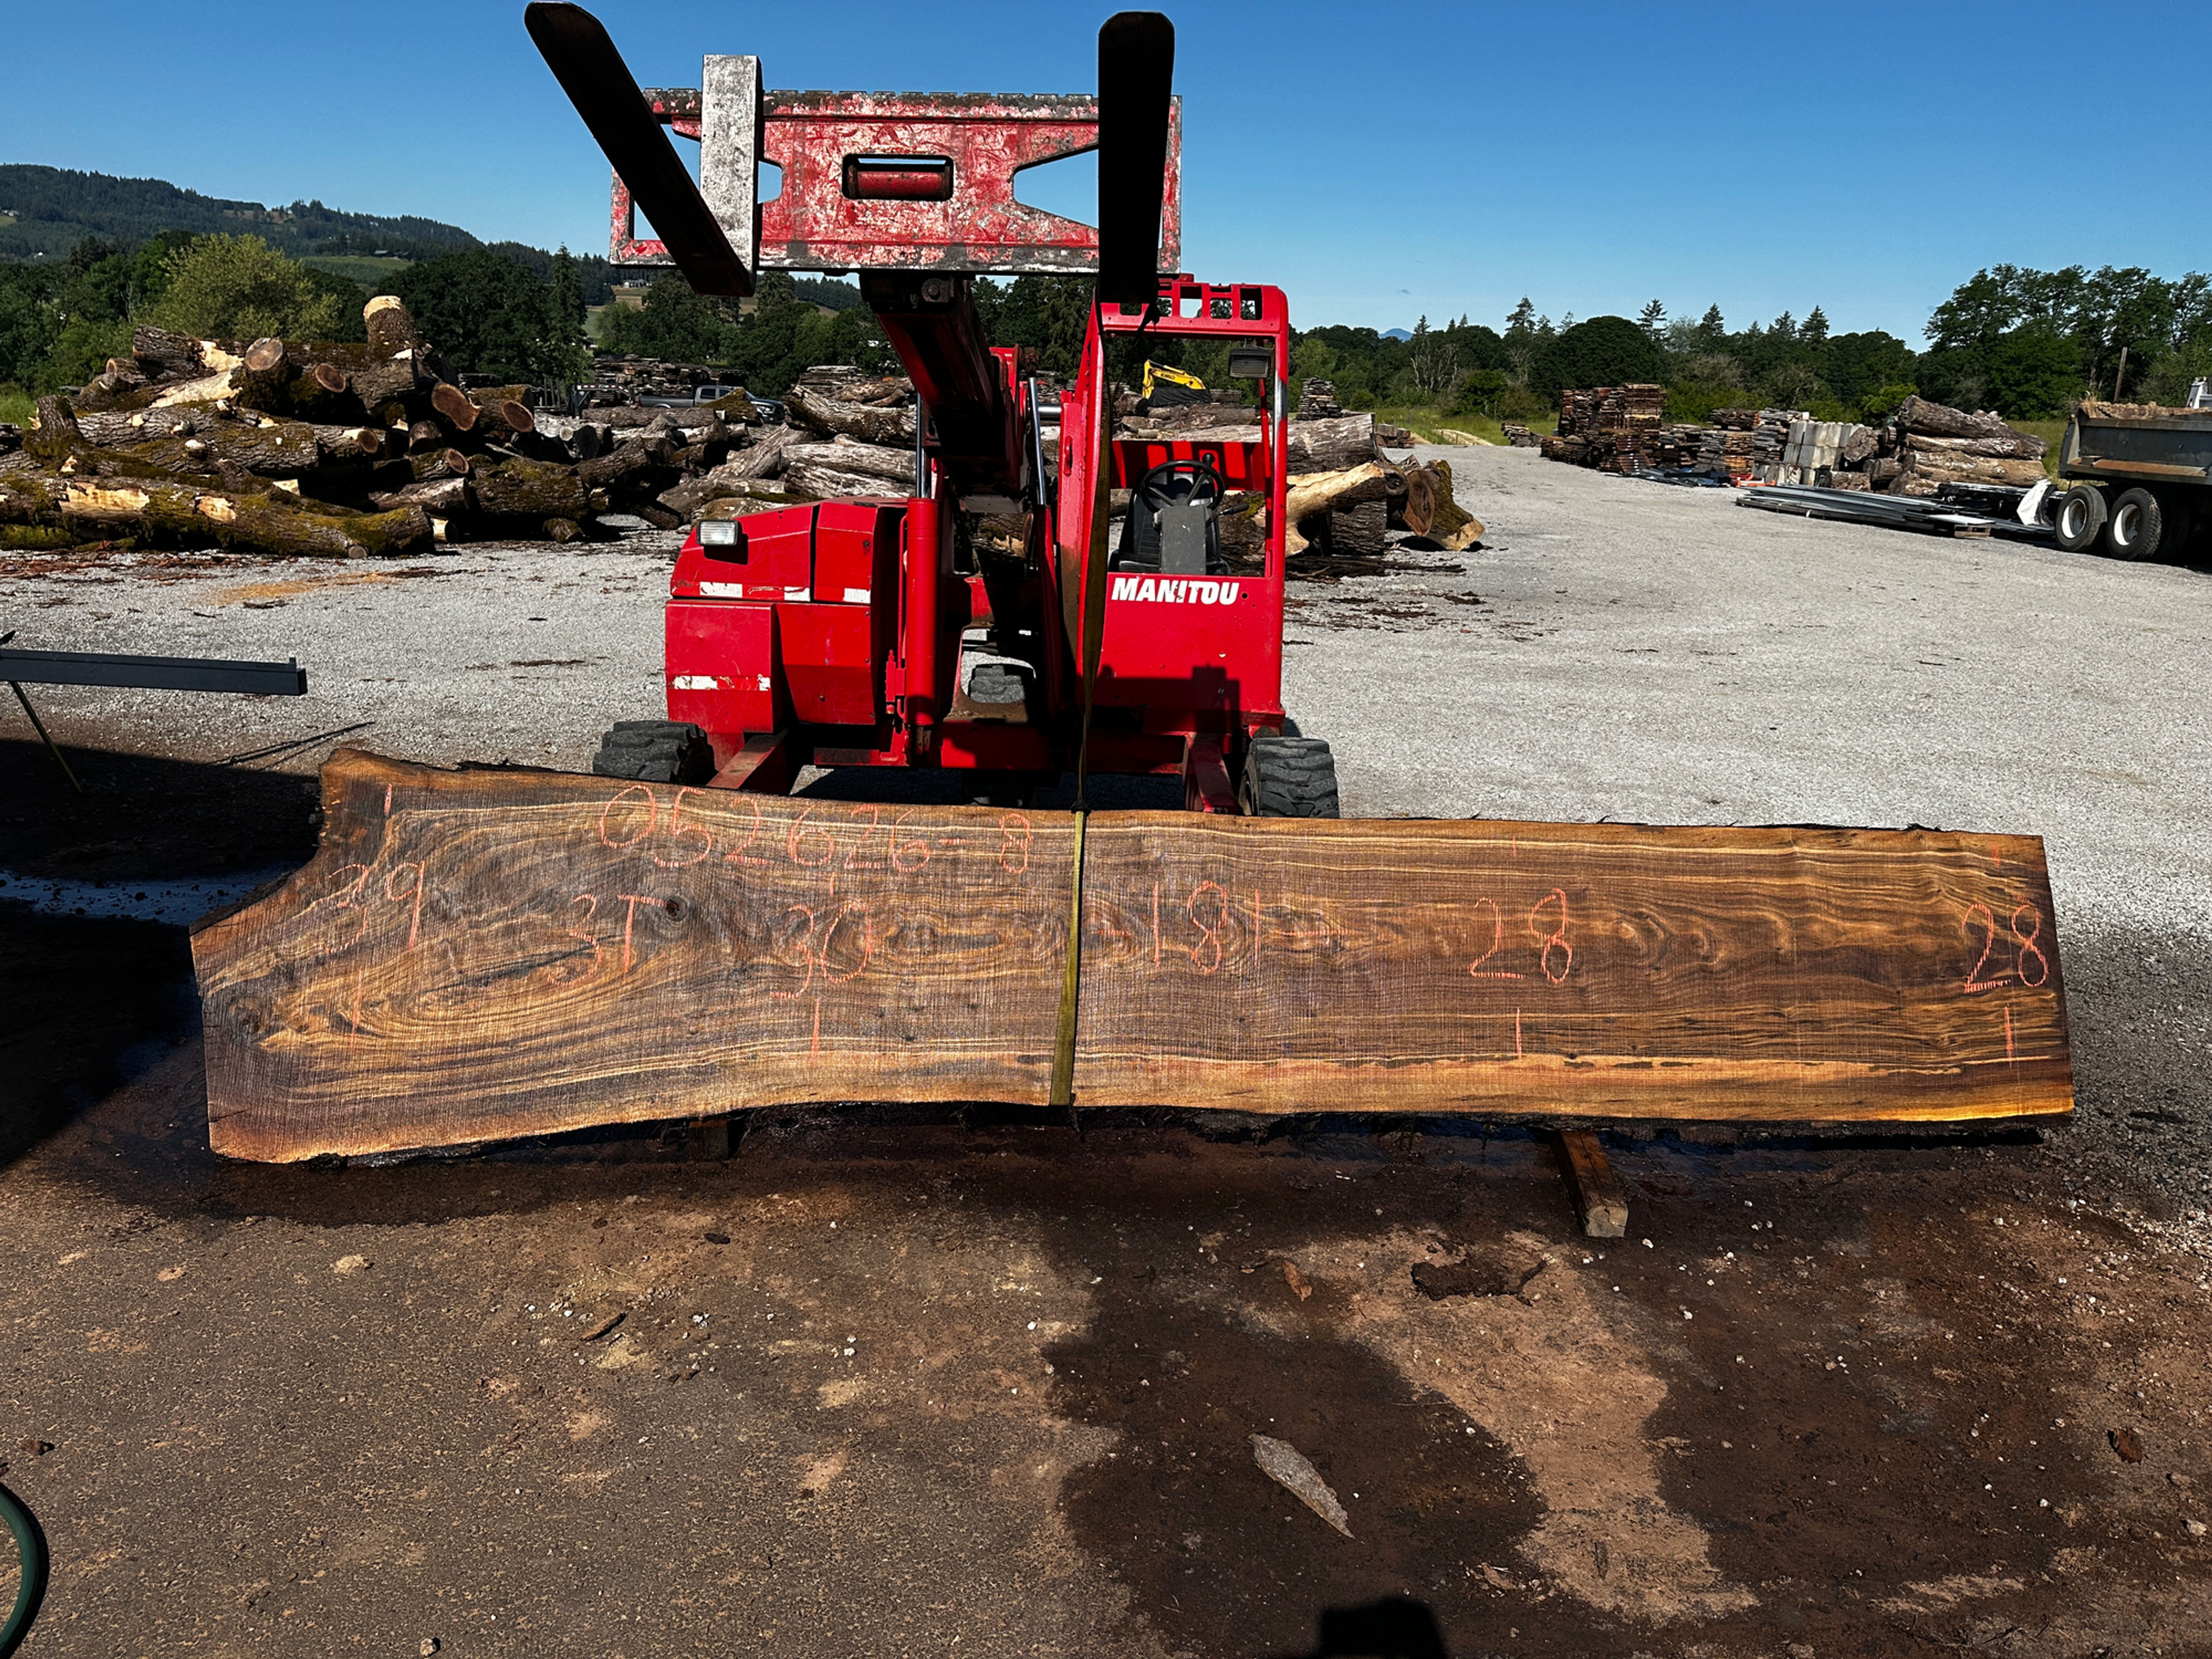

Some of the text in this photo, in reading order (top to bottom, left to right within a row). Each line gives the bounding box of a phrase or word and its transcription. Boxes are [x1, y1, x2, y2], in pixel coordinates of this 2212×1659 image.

[1111, 577, 1240, 605] MANITOU
[769, 899, 873, 998] 30
[1469, 887, 1573, 985] 28
[1962, 895, 2049, 994] 28
